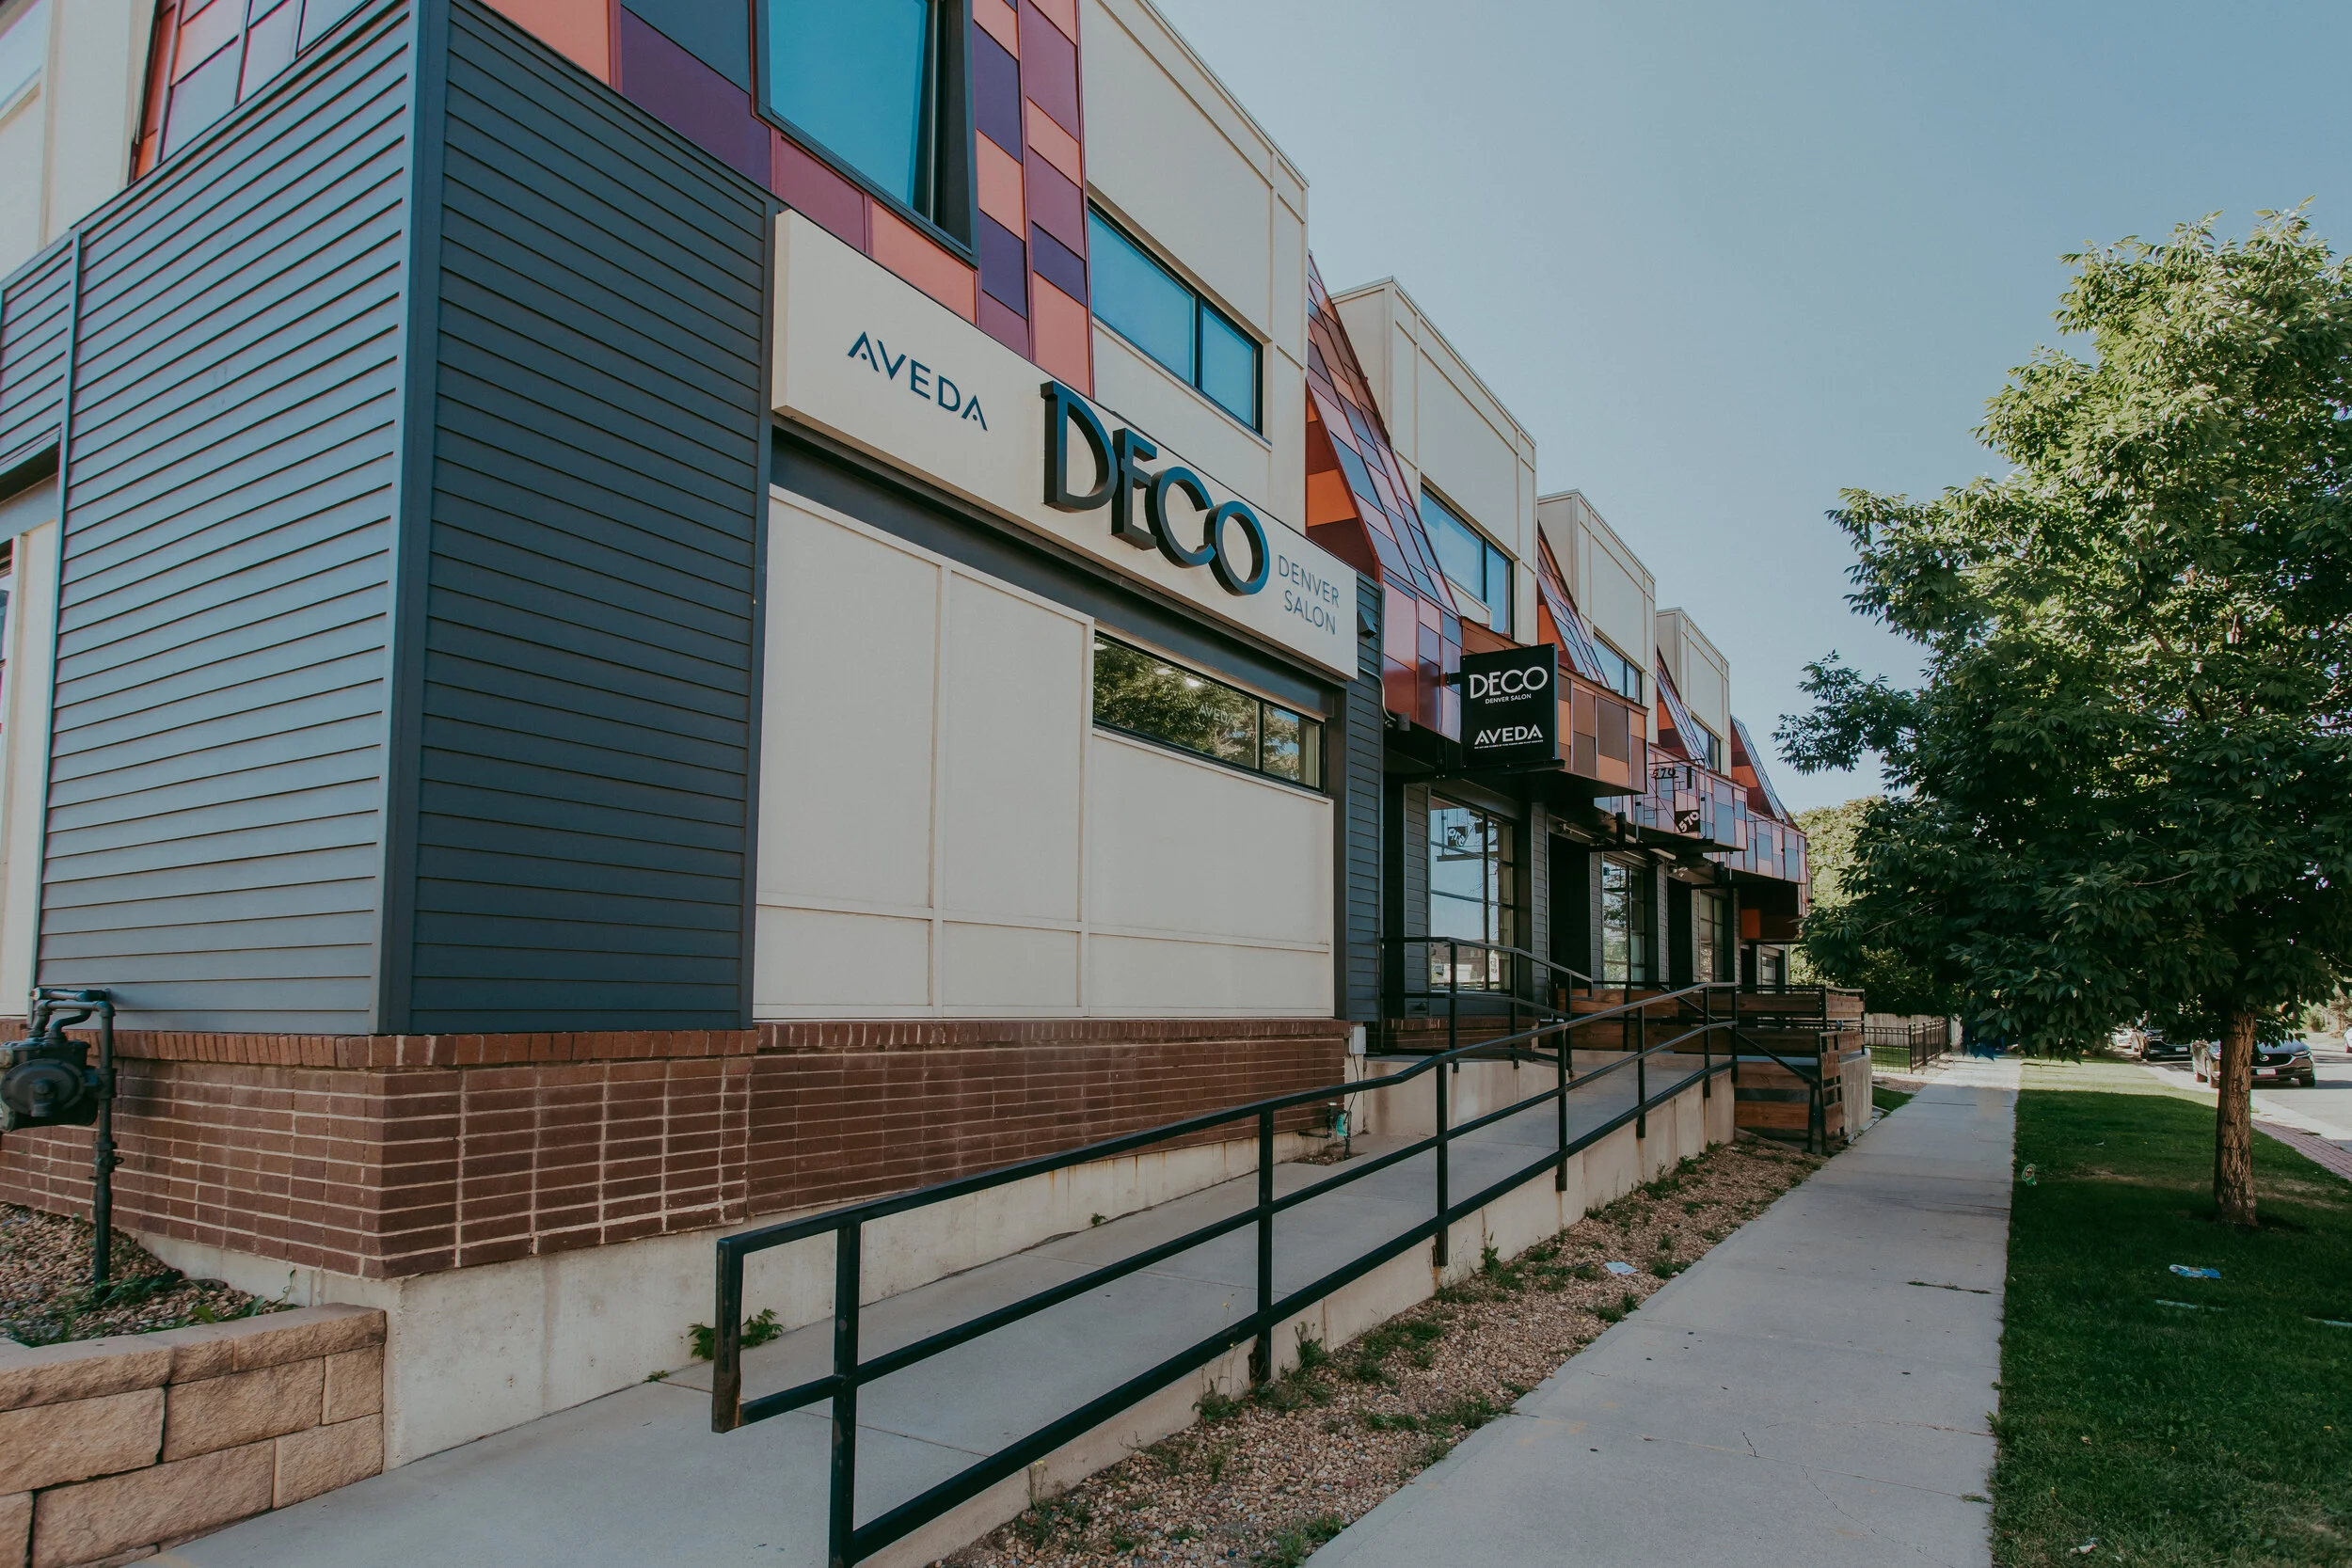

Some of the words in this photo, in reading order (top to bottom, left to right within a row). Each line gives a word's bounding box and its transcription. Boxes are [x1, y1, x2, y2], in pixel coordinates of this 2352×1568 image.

[848, 331, 988, 431] AVEDA
[1041, 380, 1270, 597] DECO
[1279, 555, 1340, 609] DENVER
[1284, 589, 1336, 635] SALON
[1469, 666, 1549, 699] DECO
[1485, 696, 1509, 705] DENVER
[1474, 723, 1544, 746] AVEDA
[1678, 811, 1700, 833] 570
